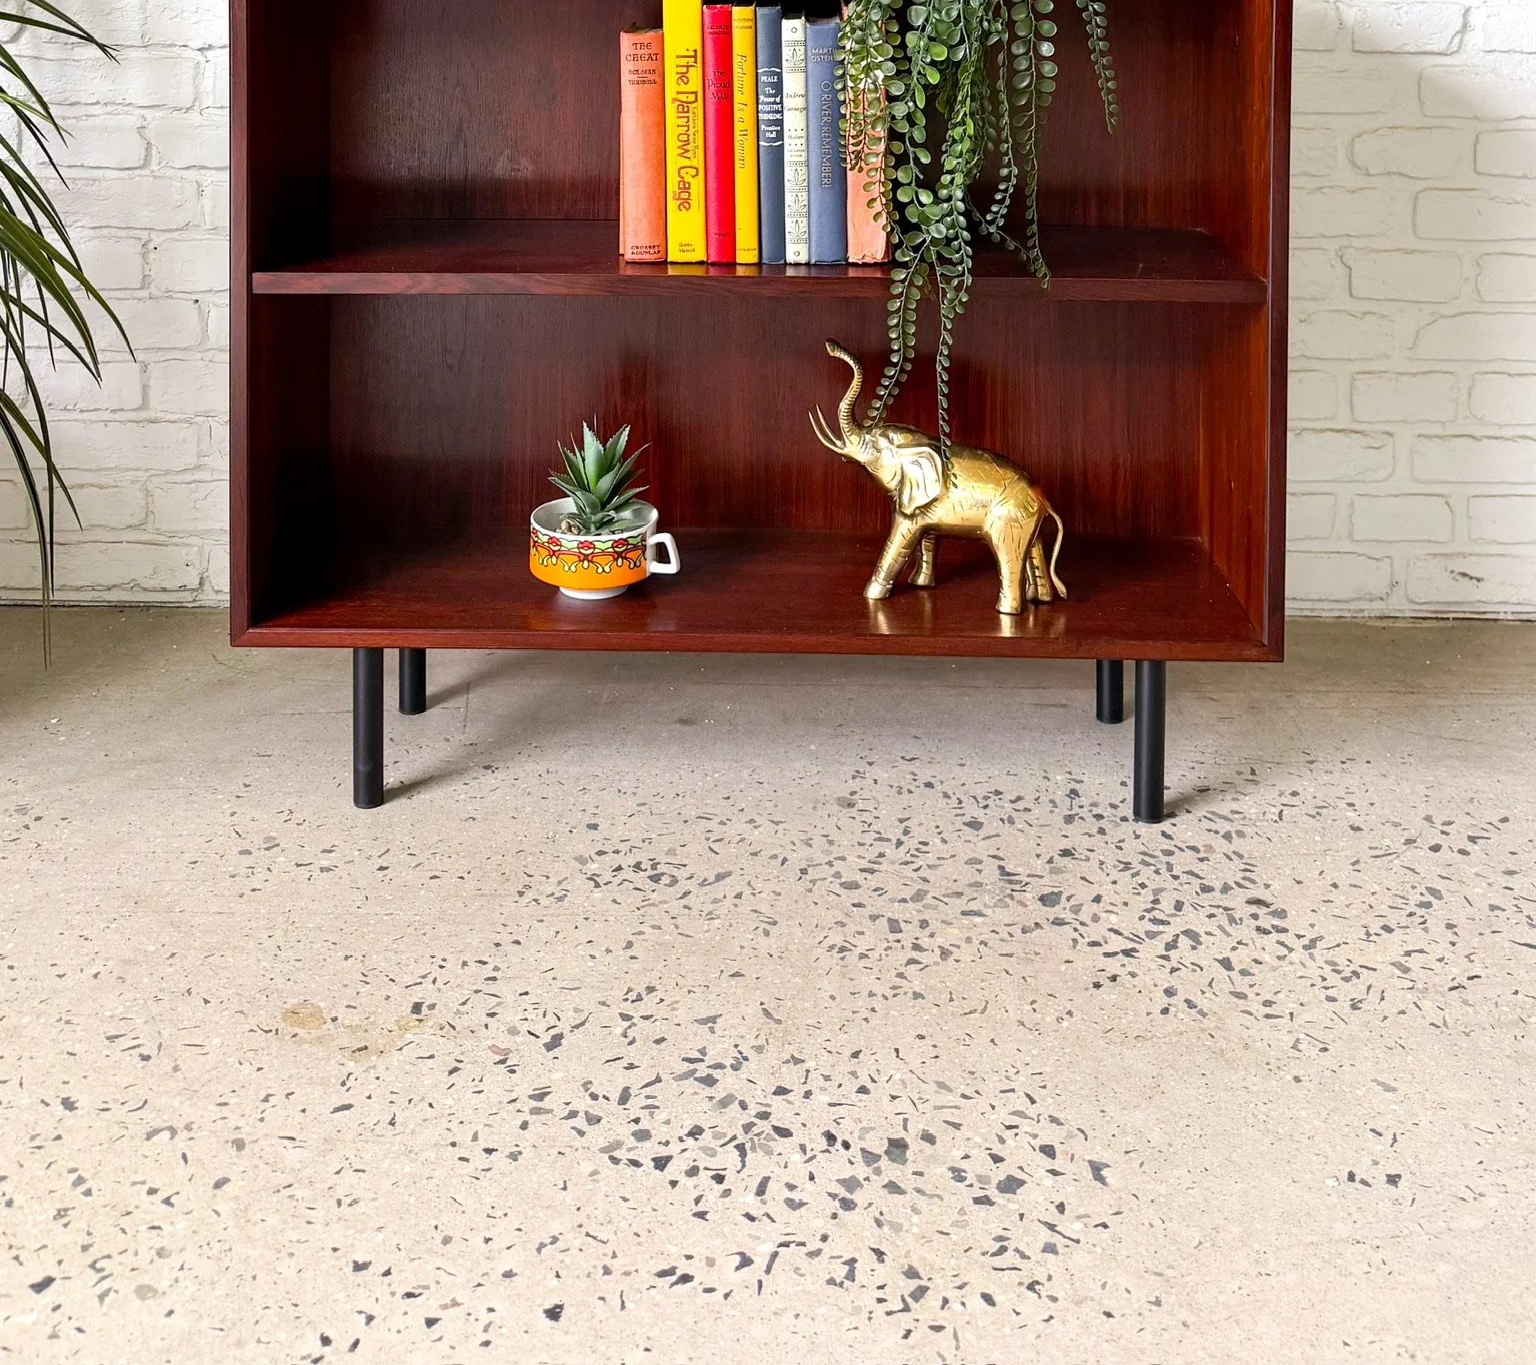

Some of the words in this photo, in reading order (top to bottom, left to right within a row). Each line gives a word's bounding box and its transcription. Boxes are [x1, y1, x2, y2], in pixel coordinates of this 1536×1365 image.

[625, 53, 660, 62] CHEAT
[632, 42, 652, 50] THE
[675, 48, 698, 86] The
[737, 53, 747, 95] Fortune
[821, 80, 831, 92] O
[738, 102, 748, 112] Is
[758, 104, 782, 112] POSITIVE
[821, 94, 832, 125] RIVER,
[671, 91, 698, 160] Narrow
[738, 129, 749, 169] Woman
[822, 126, 832, 188] REMEMBER!
[672, 165, 699, 212] Cage
